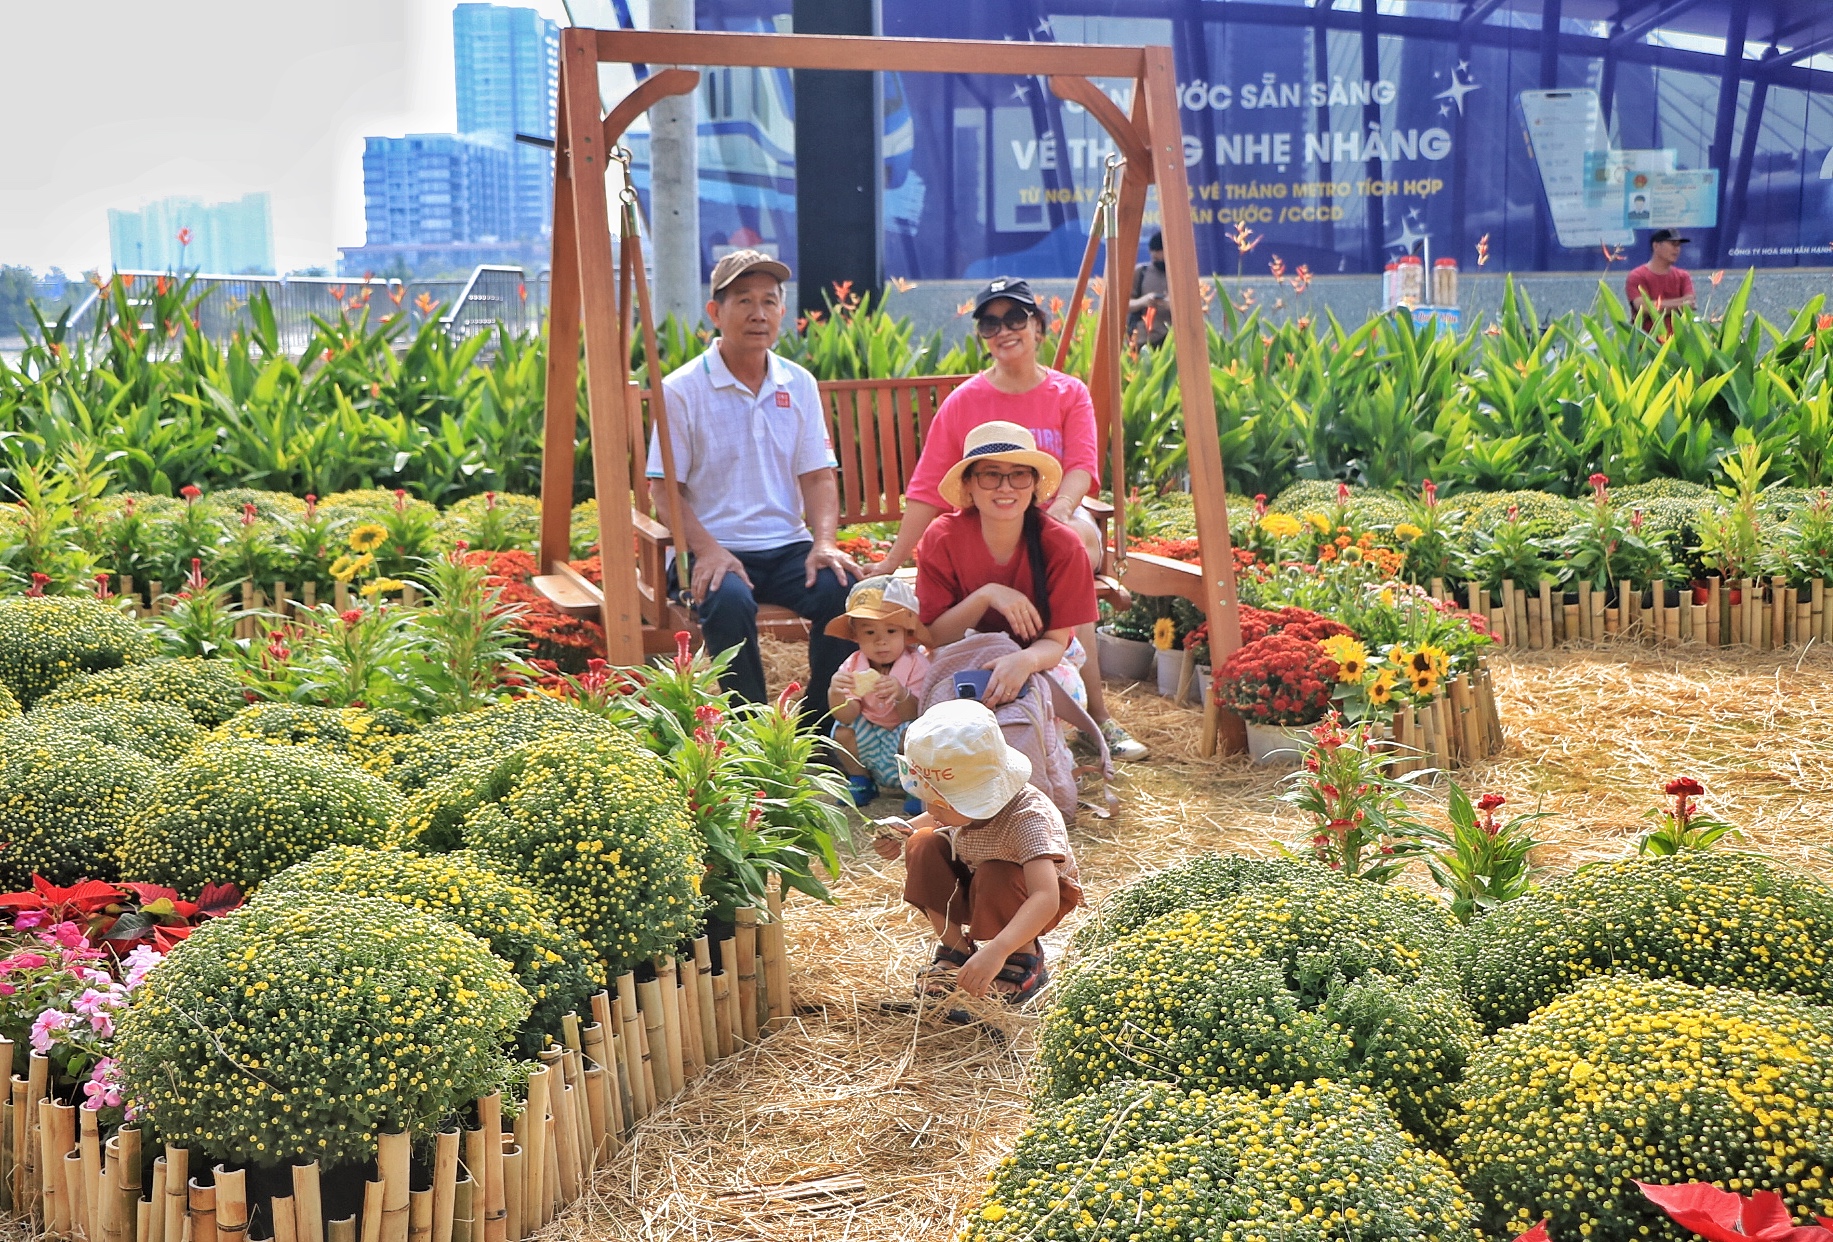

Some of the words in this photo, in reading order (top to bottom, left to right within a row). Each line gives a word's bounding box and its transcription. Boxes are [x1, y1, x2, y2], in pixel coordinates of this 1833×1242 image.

[1240, 72, 1300, 109] SẴN
[1310, 76, 1396, 107] SÀNG
[1010, 130, 1057, 171] VÉ
[1068, 135, 1203, 169] THG
[1216, 132, 1292, 174] NHẸ
[1304, 121, 1452, 163] NHÀNG
[1198, 181, 1220, 201] VÉ
[1225, 180, 1288, 199] THÁNG
[1292, 181, 1351, 199] METRO
[1357, 177, 1399, 196] TÍCH
[1403, 178, 1444, 199] HỢP
[1217, 203, 1273, 224] CƯỚC
